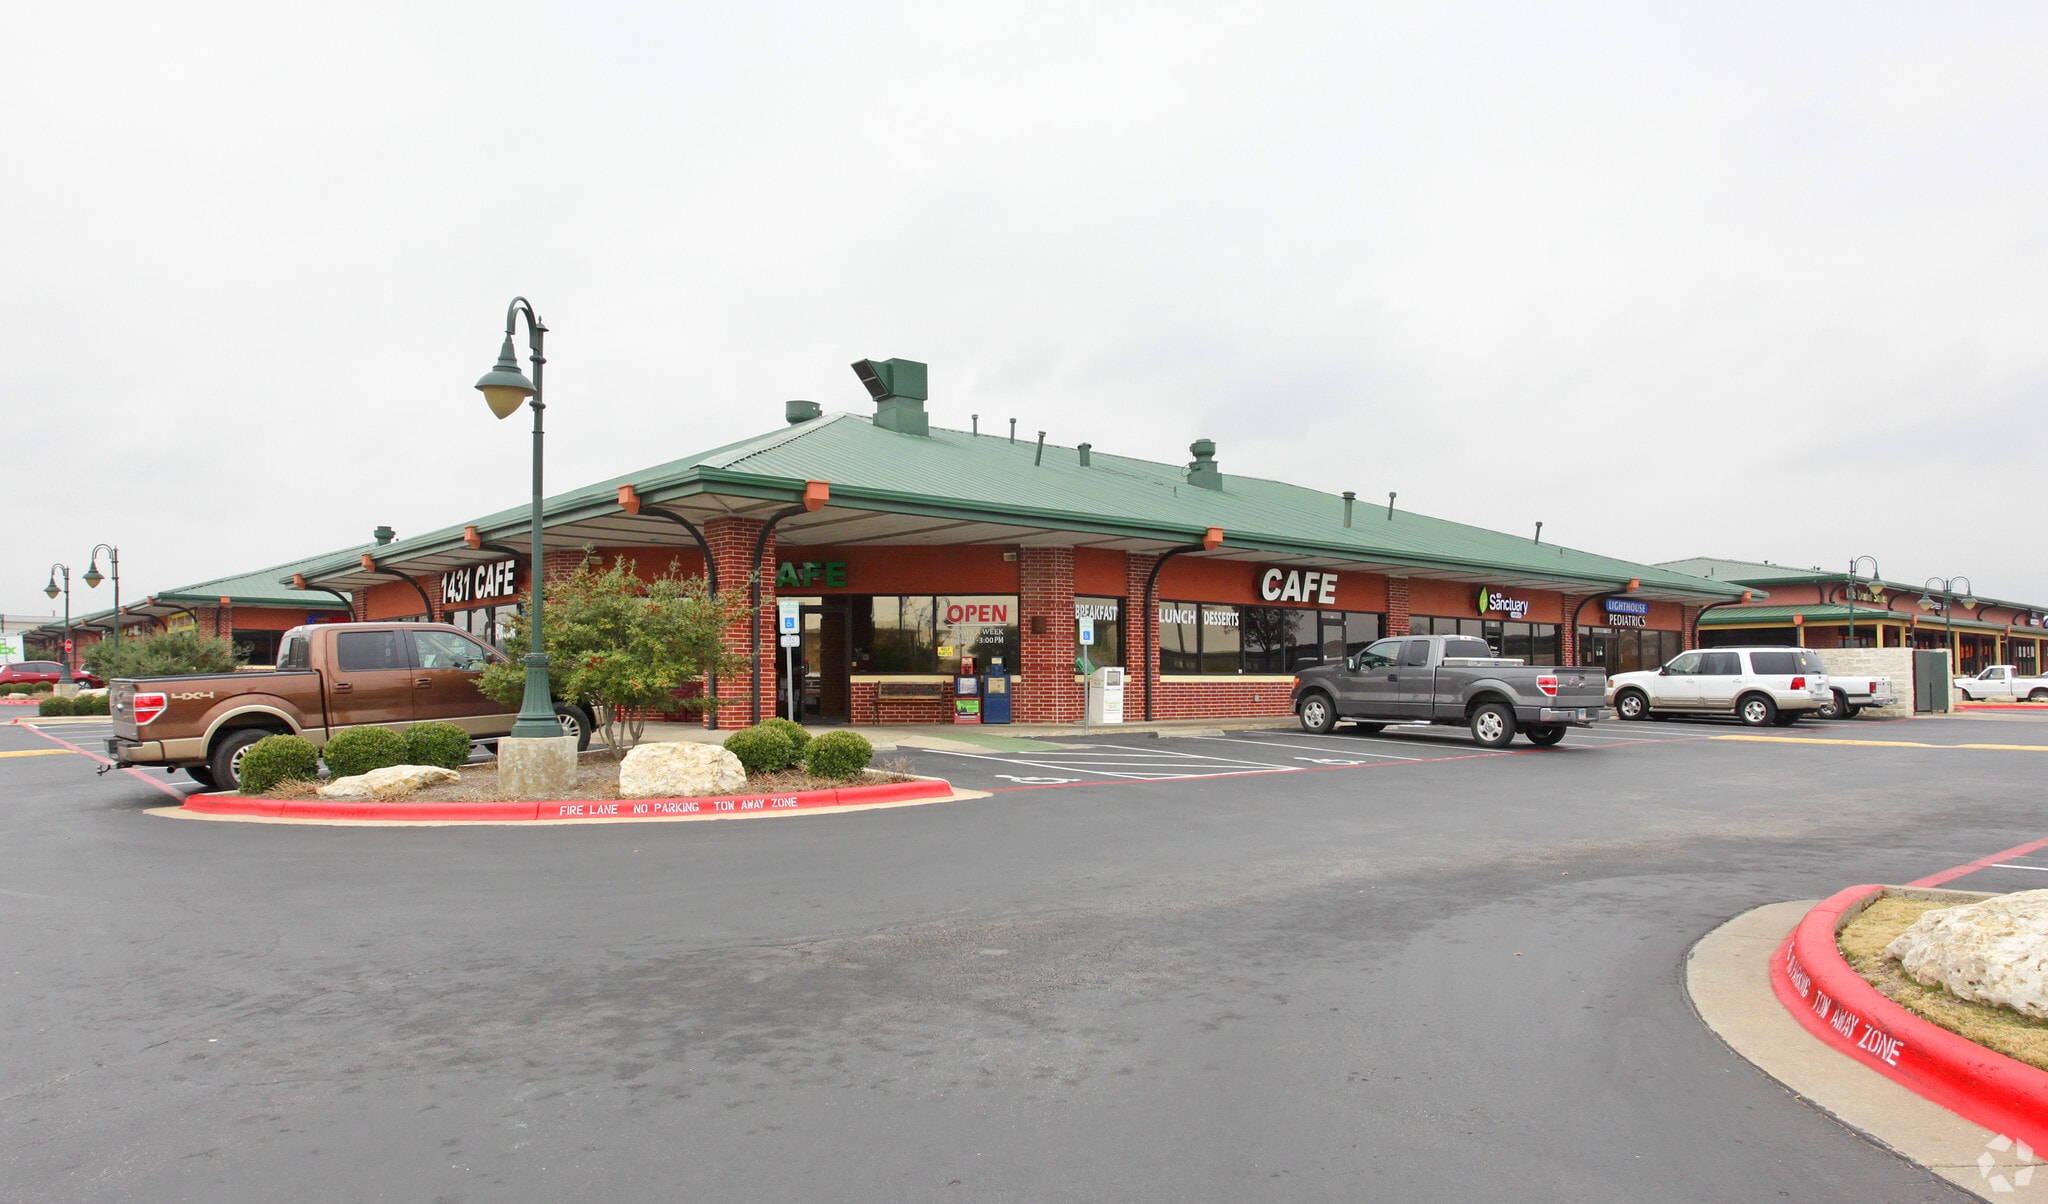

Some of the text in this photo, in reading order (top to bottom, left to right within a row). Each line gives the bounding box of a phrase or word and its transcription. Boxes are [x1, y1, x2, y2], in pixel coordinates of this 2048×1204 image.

[441, 560, 515, 604] 1431 CAFE
[1262, 568, 1338, 605] CAFE
[947, 605, 1008, 623] OPEN
[1075, 604, 1118, 621] BREAKFAST
[1489, 594, 1529, 616] Sanctuary
[1608, 600, 1646, 613] LIGHTHOUSE
[1159, 608, 1197, 625] LUNCH
[1203, 611, 1240, 627] DESSERTS
[1609, 613, 1646, 627] PEDIATRICS
[559, 797, 798, 816] FIRE LANE NO PARKING TOW AWAY ZONE
[1812, 990, 1832, 1019] TOW
[1829, 1007, 1860, 1040] AWAY
[1857, 1024, 1904, 1067] ZONE
